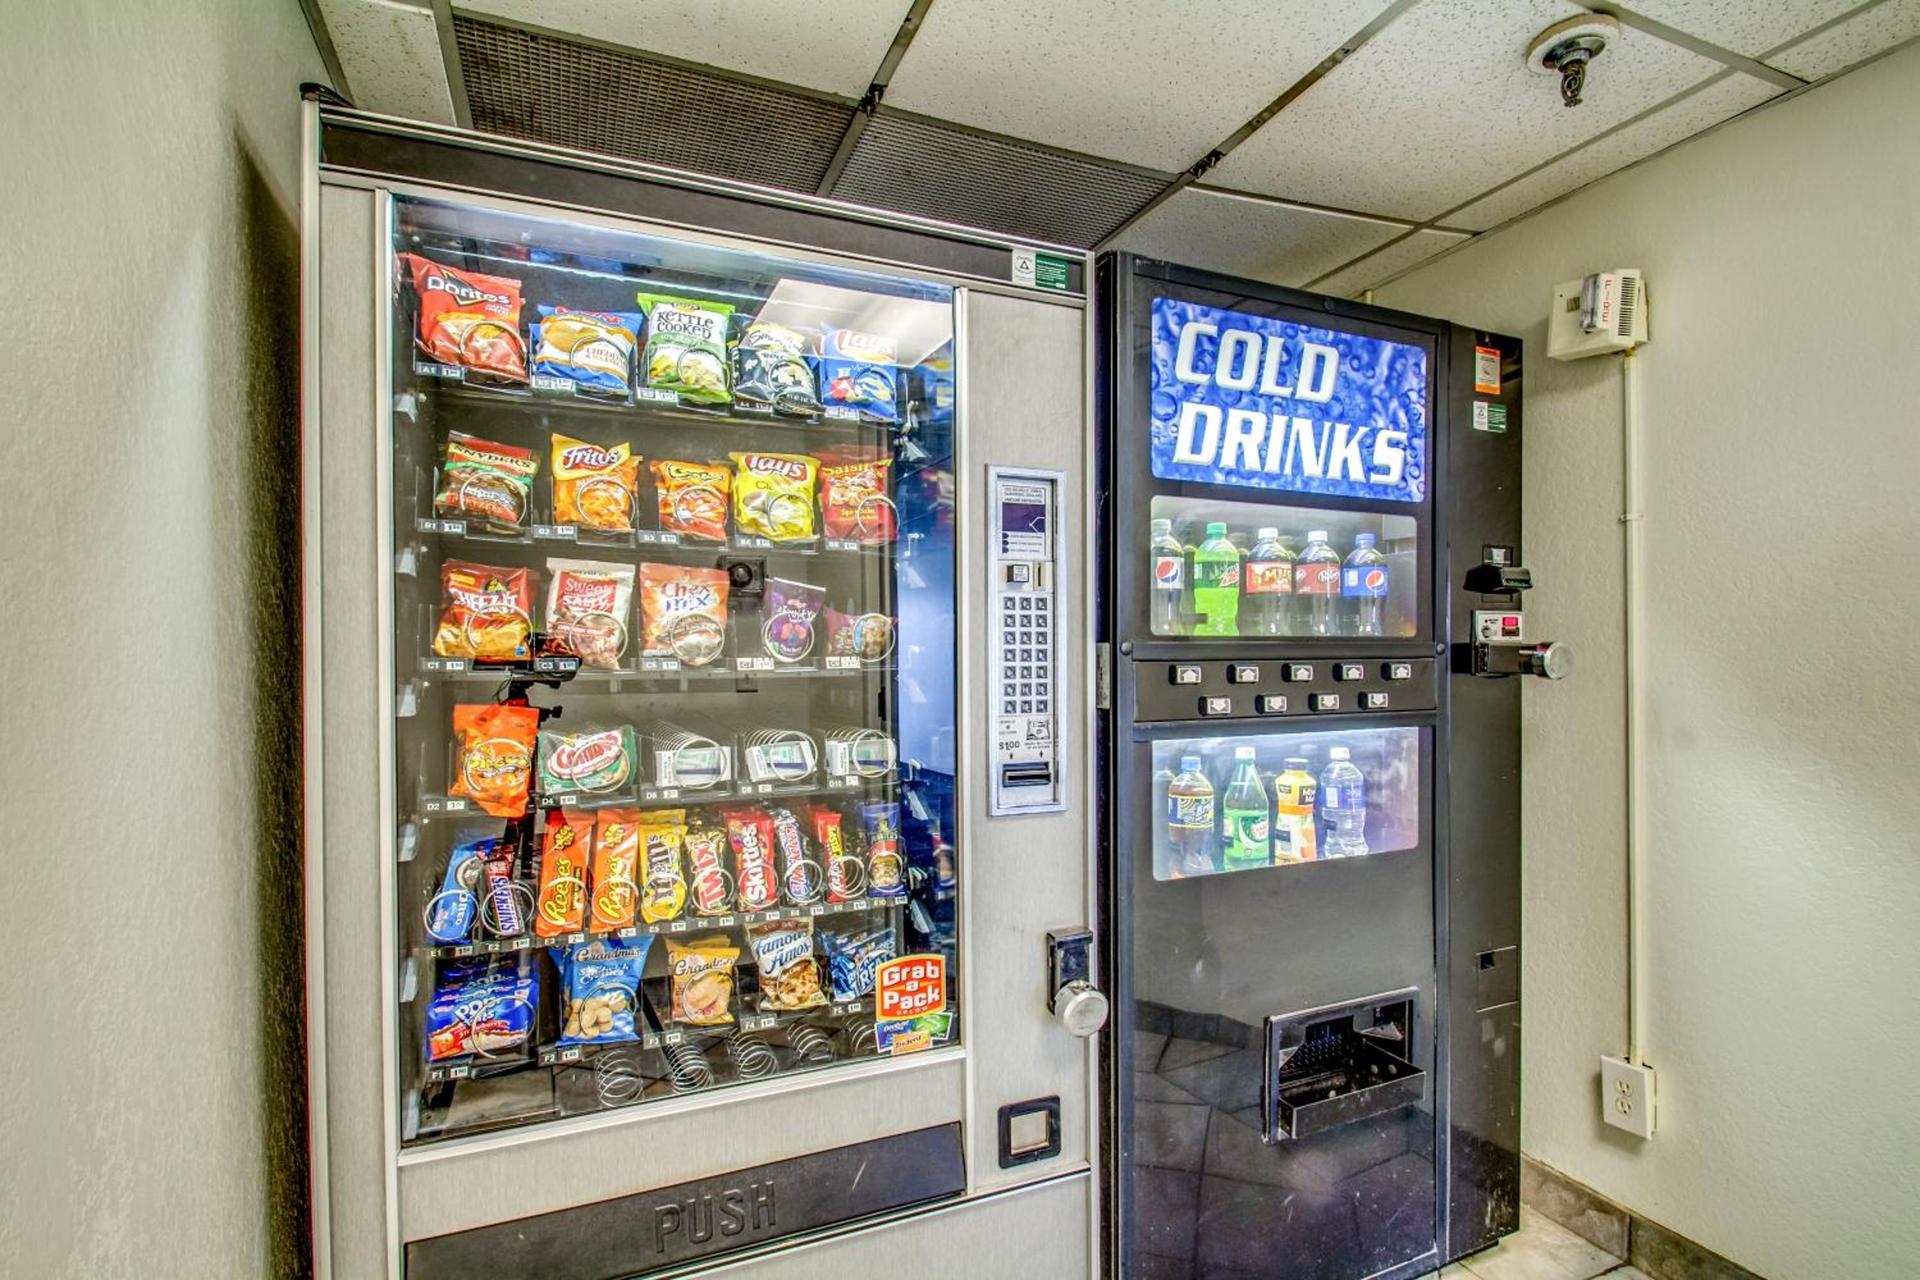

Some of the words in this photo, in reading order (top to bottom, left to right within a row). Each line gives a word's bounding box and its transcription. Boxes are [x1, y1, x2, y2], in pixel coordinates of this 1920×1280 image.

[426, 275, 511, 305] Doritos
[1602, 279, 1612, 322] FIRE
[1175, 322, 1340, 404] COLD
[563, 446, 619, 469] Fritos
[1172, 401, 1408, 486] DRINKS
[661, 583, 711, 598] Chex
[427, 803, 440, 811] D2
[492, 876, 517, 932] SNICKERS
[882, 961, 940, 986] Grab
[905, 980, 919, 992] a
[882, 984, 941, 1010] Pack
[655, 1181, 777, 1254] PUSH
